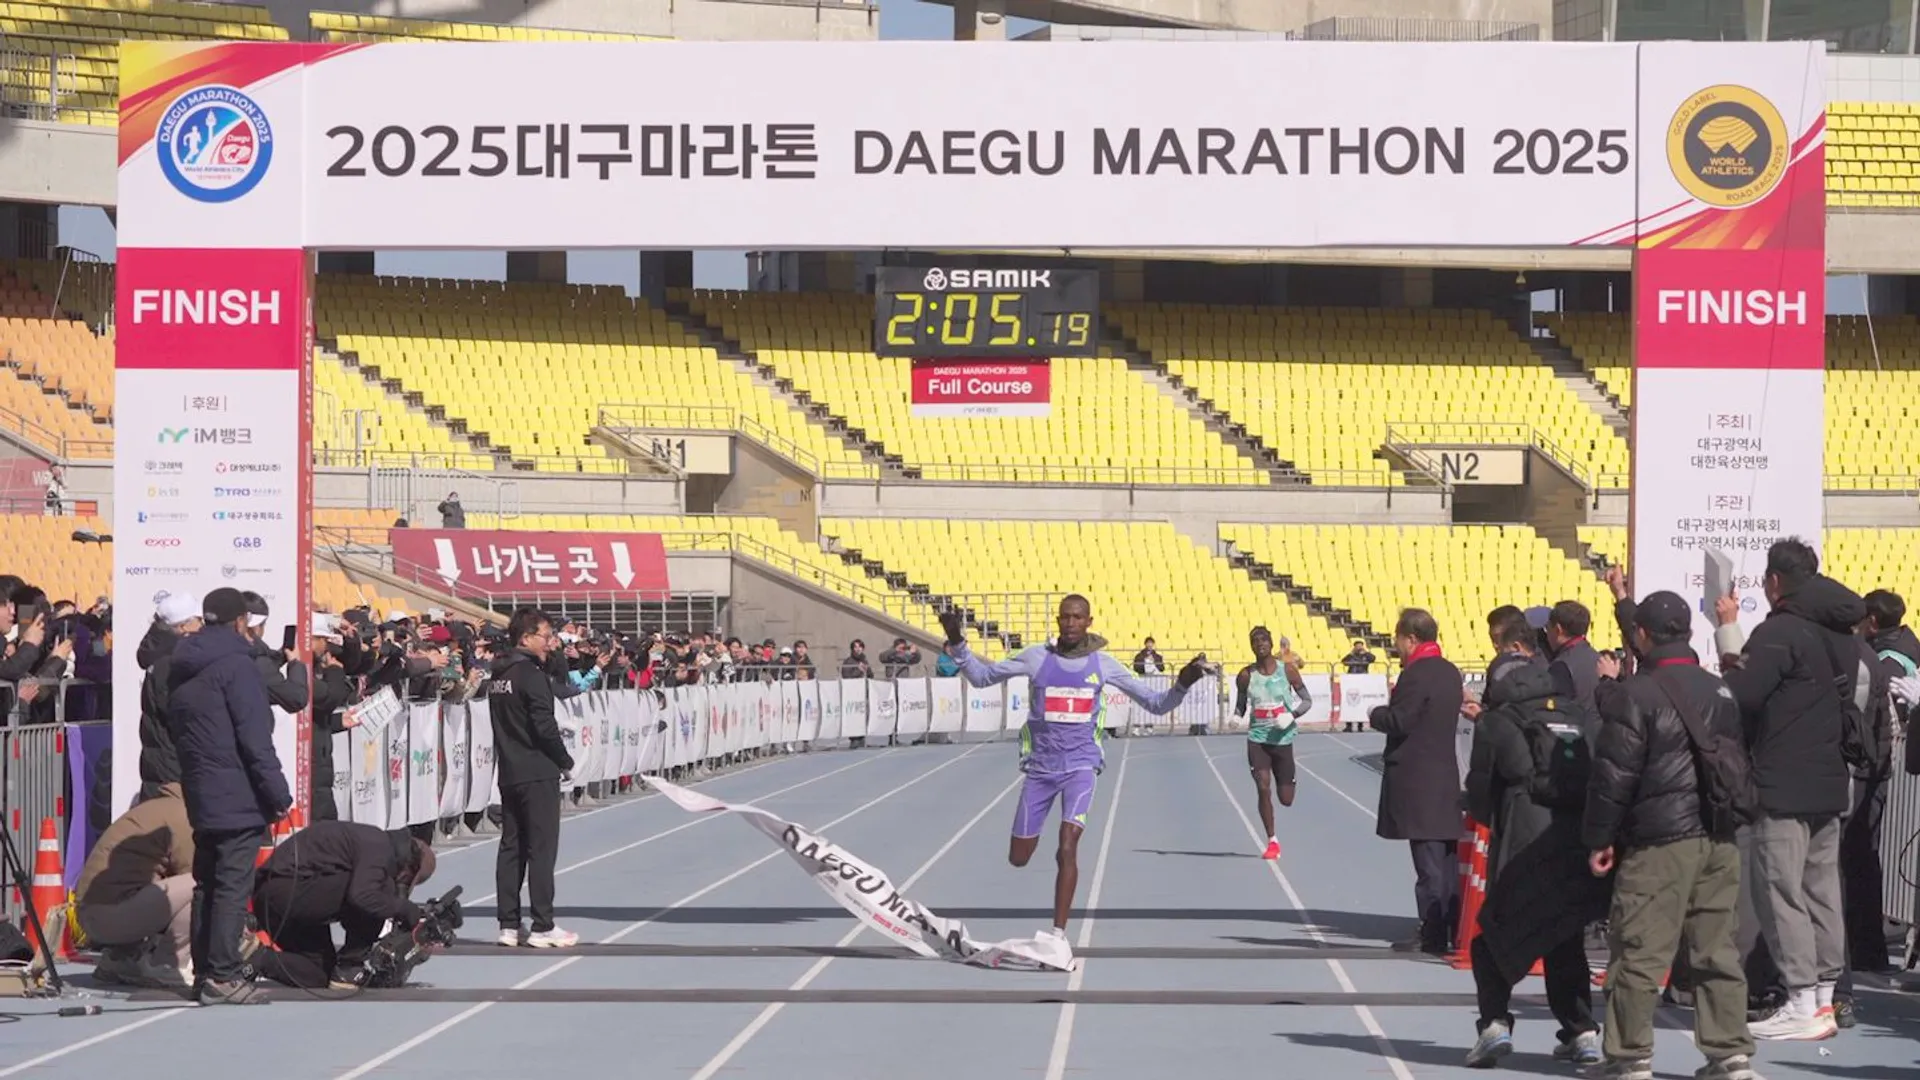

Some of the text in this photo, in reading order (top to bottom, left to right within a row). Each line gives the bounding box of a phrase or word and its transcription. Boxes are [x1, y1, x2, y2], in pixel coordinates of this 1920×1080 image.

[160, 89, 271, 143] DAEGU MARATHON 2025
[1673, 92, 1718, 136] GOLD LABEL
[325, 123, 1630, 179] 2025대구마라톤 DAEGU MARATHON 2025
[1709, 156, 1746, 166] WORLD
[1701, 166, 1754, 176] ATHLETICS
[1725, 144, 1785, 201] ROAD RACE 2025
[949, 269, 1051, 288] SAMIK
[132, 289, 280, 325] FINISH
[1658, 289, 1807, 326] FINISH
[933, 366, 1028, 375] DAEGU MARATHON 2025
[928, 378, 1033, 395] Full Course
[192, 396, 220, 411] 후원
[1716, 414, 1745, 429] 주최
[1697, 437, 1762, 452] 대구광역시
[1441, 452, 1480, 481] N2
[1690, 454, 1769, 470] 대한육상연맹
[1714, 495, 1743, 511] 주관
[1677, 518, 1781, 533] 대구광역시체육회
[144, 537, 181, 548] exco
[233, 536, 262, 548] G&B
[1670, 535, 1783, 551] 대구광역시육상연
[471, 544, 599, 585] 나가는 곳
[1066, 698, 1075, 713] 1
